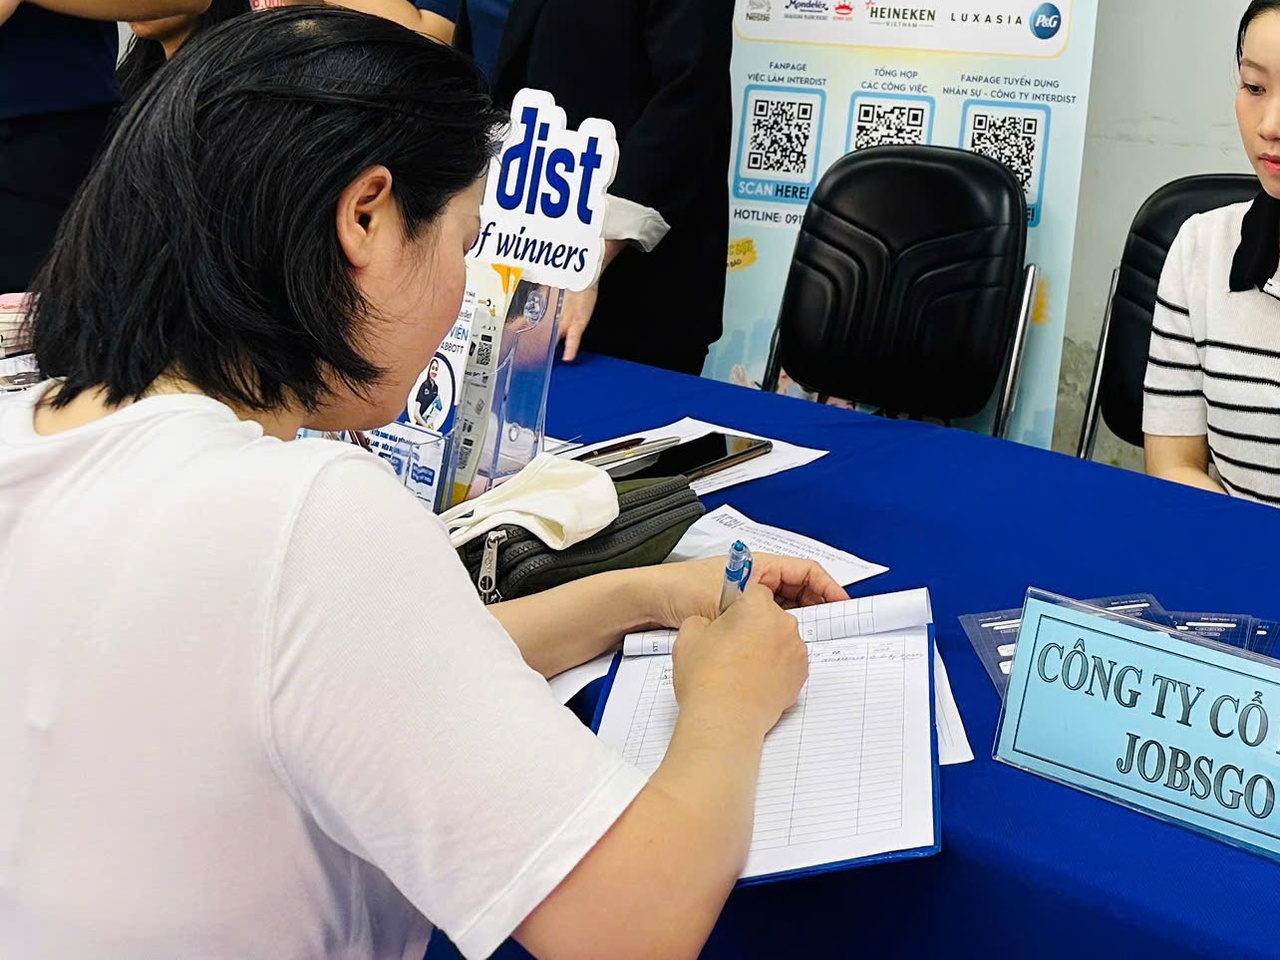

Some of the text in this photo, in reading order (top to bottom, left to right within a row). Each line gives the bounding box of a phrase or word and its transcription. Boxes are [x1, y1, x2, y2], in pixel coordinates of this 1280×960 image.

[869, 6, 936, 21] HEINEKEN
[950, 13, 1023, 25] LUXASIA
[1035, 14, 1060, 28] P&G
[769, 61, 807, 72] FANPAGE
[787, 76, 828, 86] INTERDIST
[960, 74, 1001, 85] FANPAGE
[1019, 91, 1030, 101] TY
[1032, 93, 1077, 104] INTERDIST
[738, 181, 810, 199] SCAN HERE!
[733, 208, 805, 225] HOTLINE: 091
[495, 226, 589, 273] winners
[1036, 638, 1144, 709] CÔNG
[1151, 672, 1206, 728] TY
[1208, 690, 1269, 748] CỔ
[1115, 731, 1276, 820] JOBSGO
